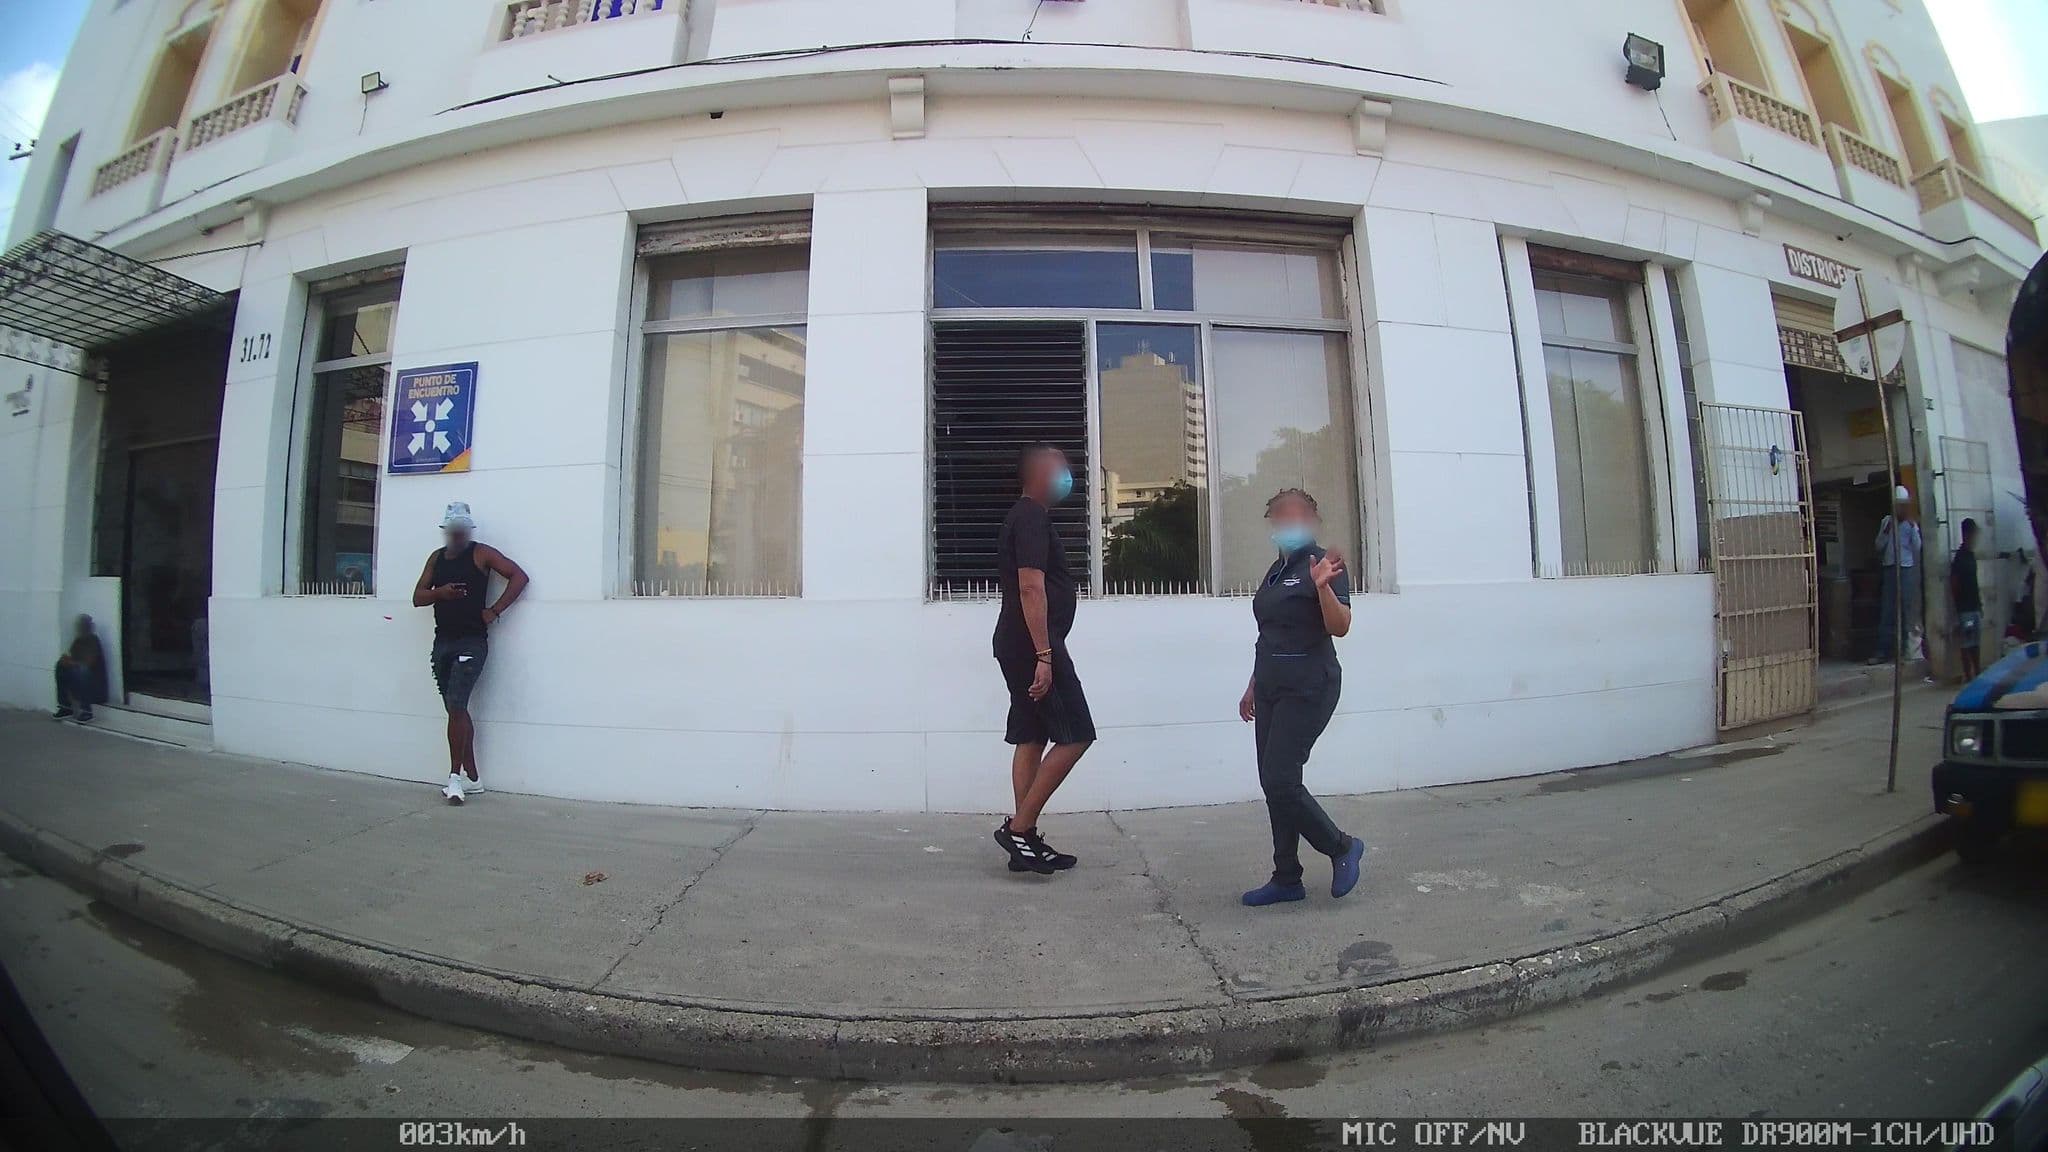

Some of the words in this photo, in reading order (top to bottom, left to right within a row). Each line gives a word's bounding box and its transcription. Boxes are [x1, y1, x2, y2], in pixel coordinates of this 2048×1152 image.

[413, 375, 443, 388] PUNTO
[444, 374, 457, 385] DE
[408, 385, 460, 399] ENCUENTRO
